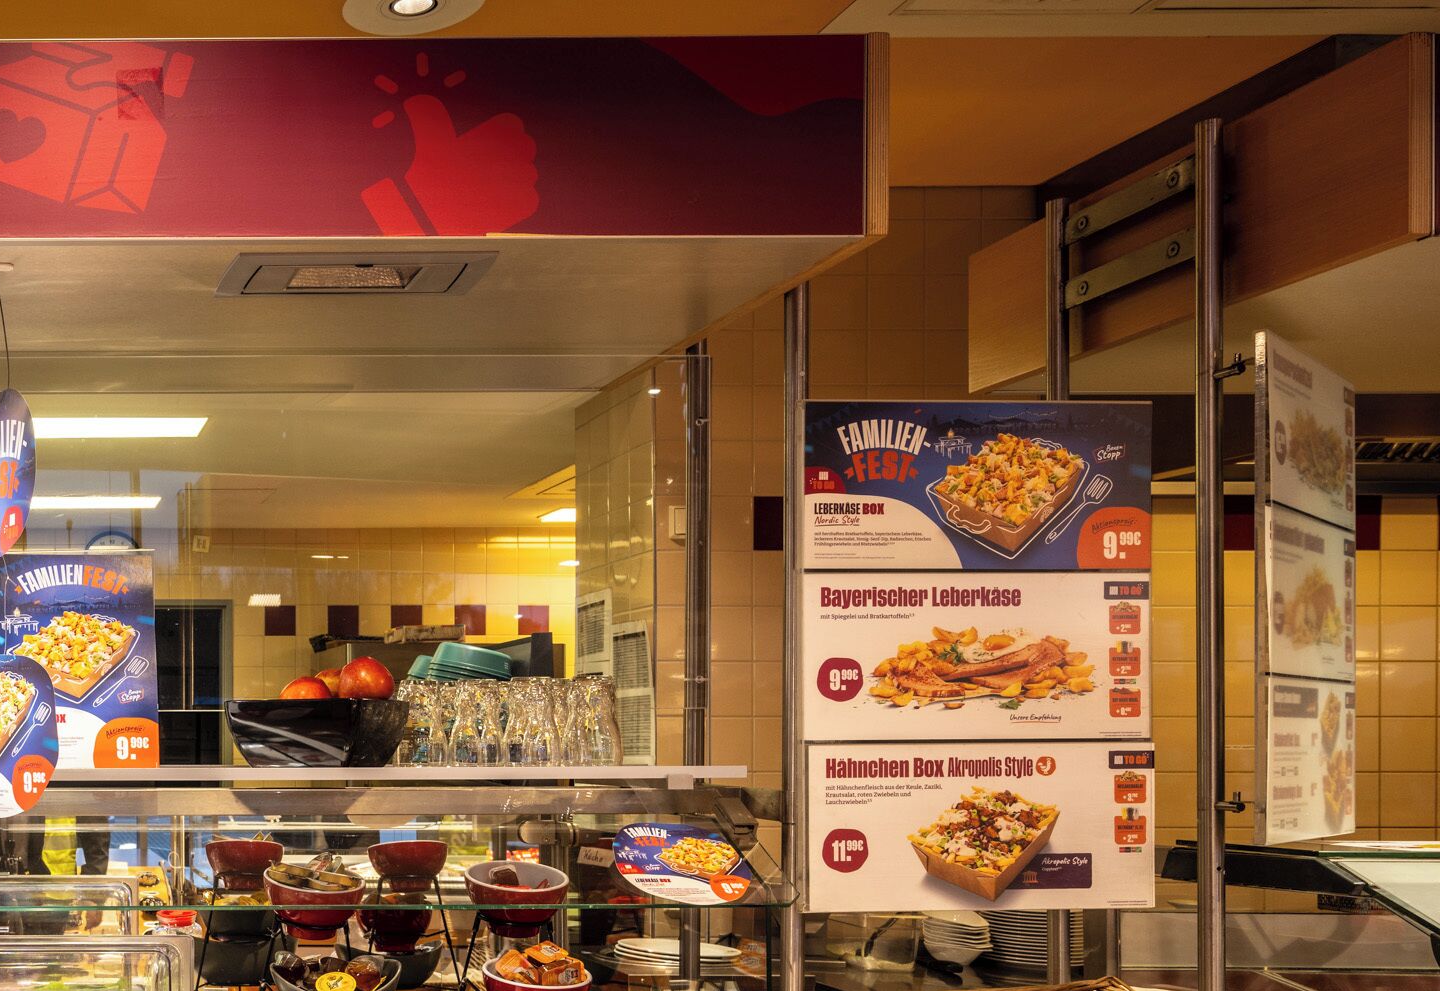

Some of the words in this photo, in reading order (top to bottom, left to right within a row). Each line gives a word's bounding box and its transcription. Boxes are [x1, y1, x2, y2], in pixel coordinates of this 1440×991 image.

[836, 418, 932, 456] FAMILIEN-
[1096, 449, 1121, 461] Stopp
[850, 450, 916, 484] FEST
[814, 502, 860, 515] LEBERKÄSE
[862, 503, 885, 515] BOX
[814, 515, 839, 525] Nordic
[841, 515, 860, 526] Style
[16, 564, 128, 595] FAMILIENFEST
[820, 587, 928, 609] Bayerischer
[931, 587, 1021, 608] Leberkäse
[1010, 713, 1029, 721] Unsere
[1030, 712, 1062, 723] Empfehlung
[1124, 755, 1135, 765] TO
[825, 757, 909, 779] Hähnchen
[913, 757, 944, 778] Box
[948, 757, 1002, 779] Akropolis
[1004, 756, 1033, 780] Style
[623, 827, 671, 839] FAMILIEN-
[831, 839, 864, 862] 11.99€
[1041, 856, 1071, 866] Akropolis
[1072, 856, 1088, 867] Style
